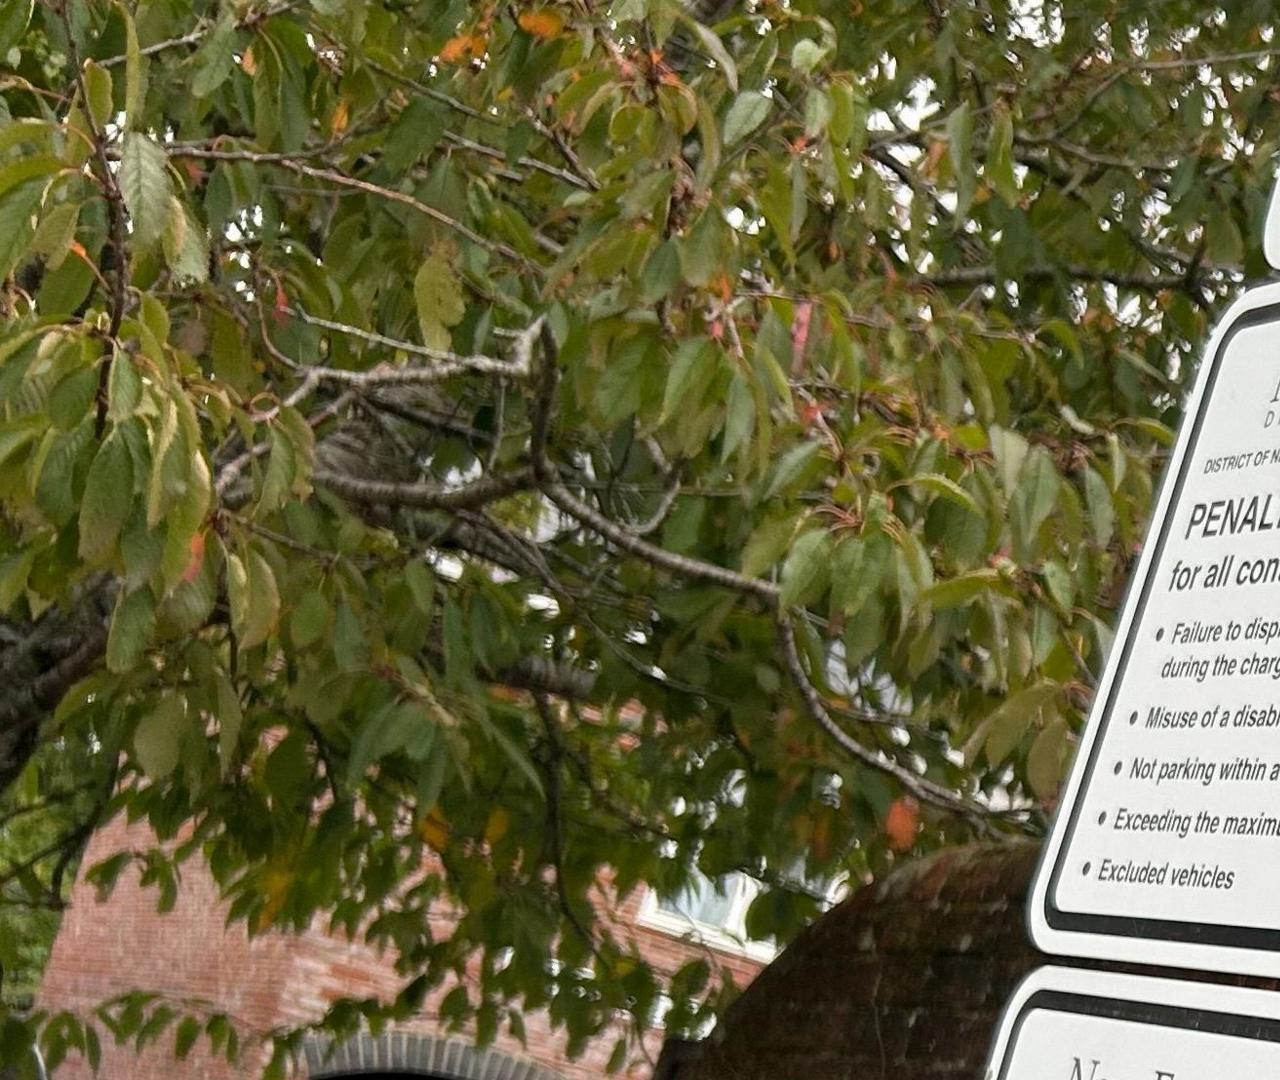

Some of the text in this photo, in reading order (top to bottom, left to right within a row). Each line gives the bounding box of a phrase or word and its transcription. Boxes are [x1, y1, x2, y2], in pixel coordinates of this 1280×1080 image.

[1168, 560, 1201, 591] for
[1203, 555, 1234, 588] all
[1145, 706, 1197, 728] Misuse
[1201, 705, 1220, 727] of
[1219, 710, 1229, 727] a
